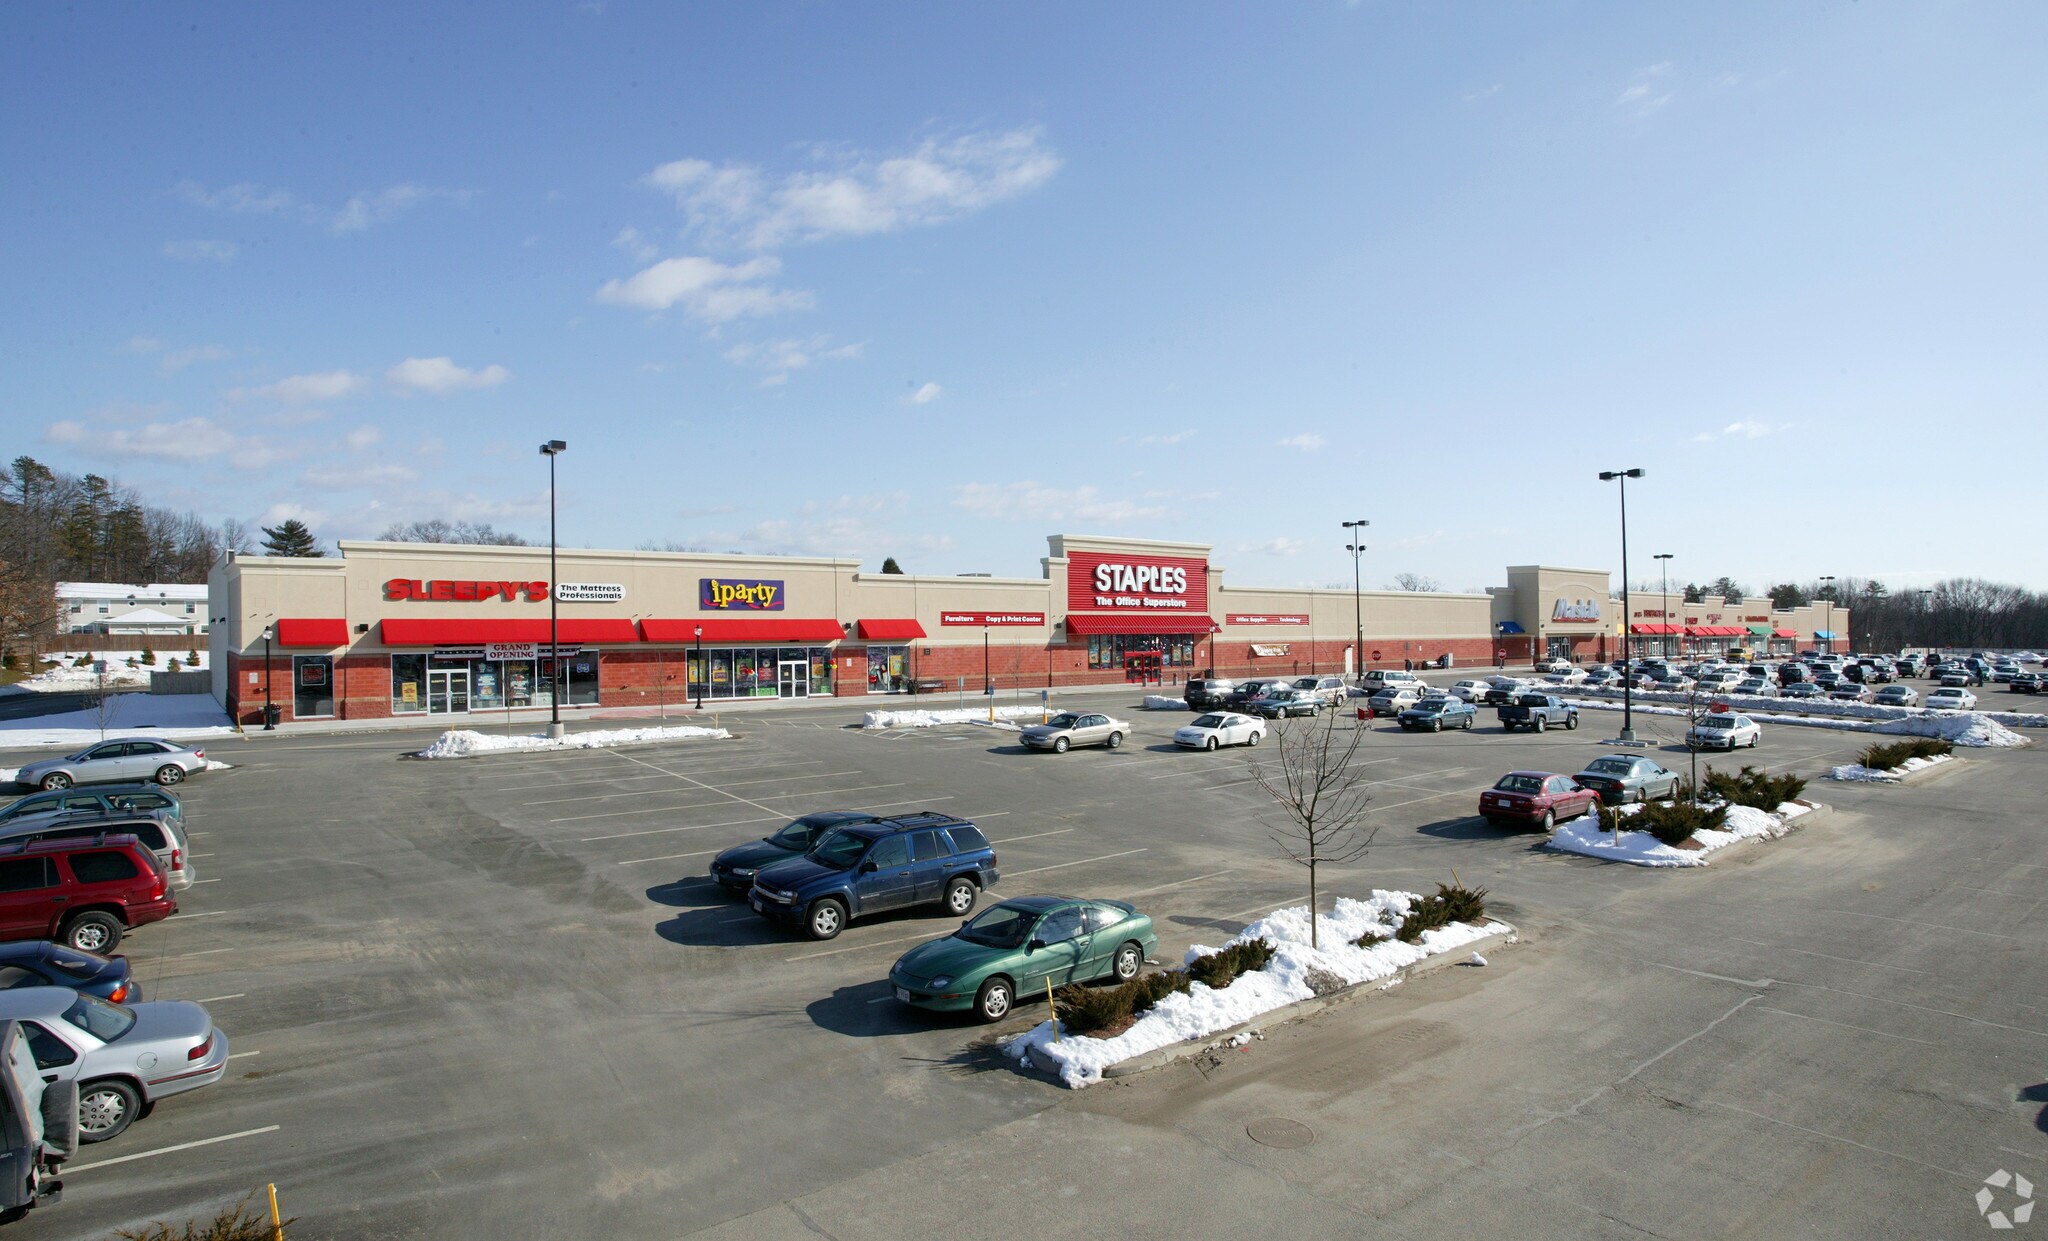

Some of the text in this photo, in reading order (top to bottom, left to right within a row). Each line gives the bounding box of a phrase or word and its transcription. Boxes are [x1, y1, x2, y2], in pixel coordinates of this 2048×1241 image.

[1096, 564, 1187, 594] STAPLES
[385, 578, 549, 602] SLEEPY'S
[561, 584, 621, 592] The Mattress
[711, 579, 777, 607] iparty
[1096, 597, 1187, 607] The Office Superstore
[985, 615, 1001, 623] Copy
[493, 643, 530, 651] GRAND
[489, 651, 534, 659] OPENING
